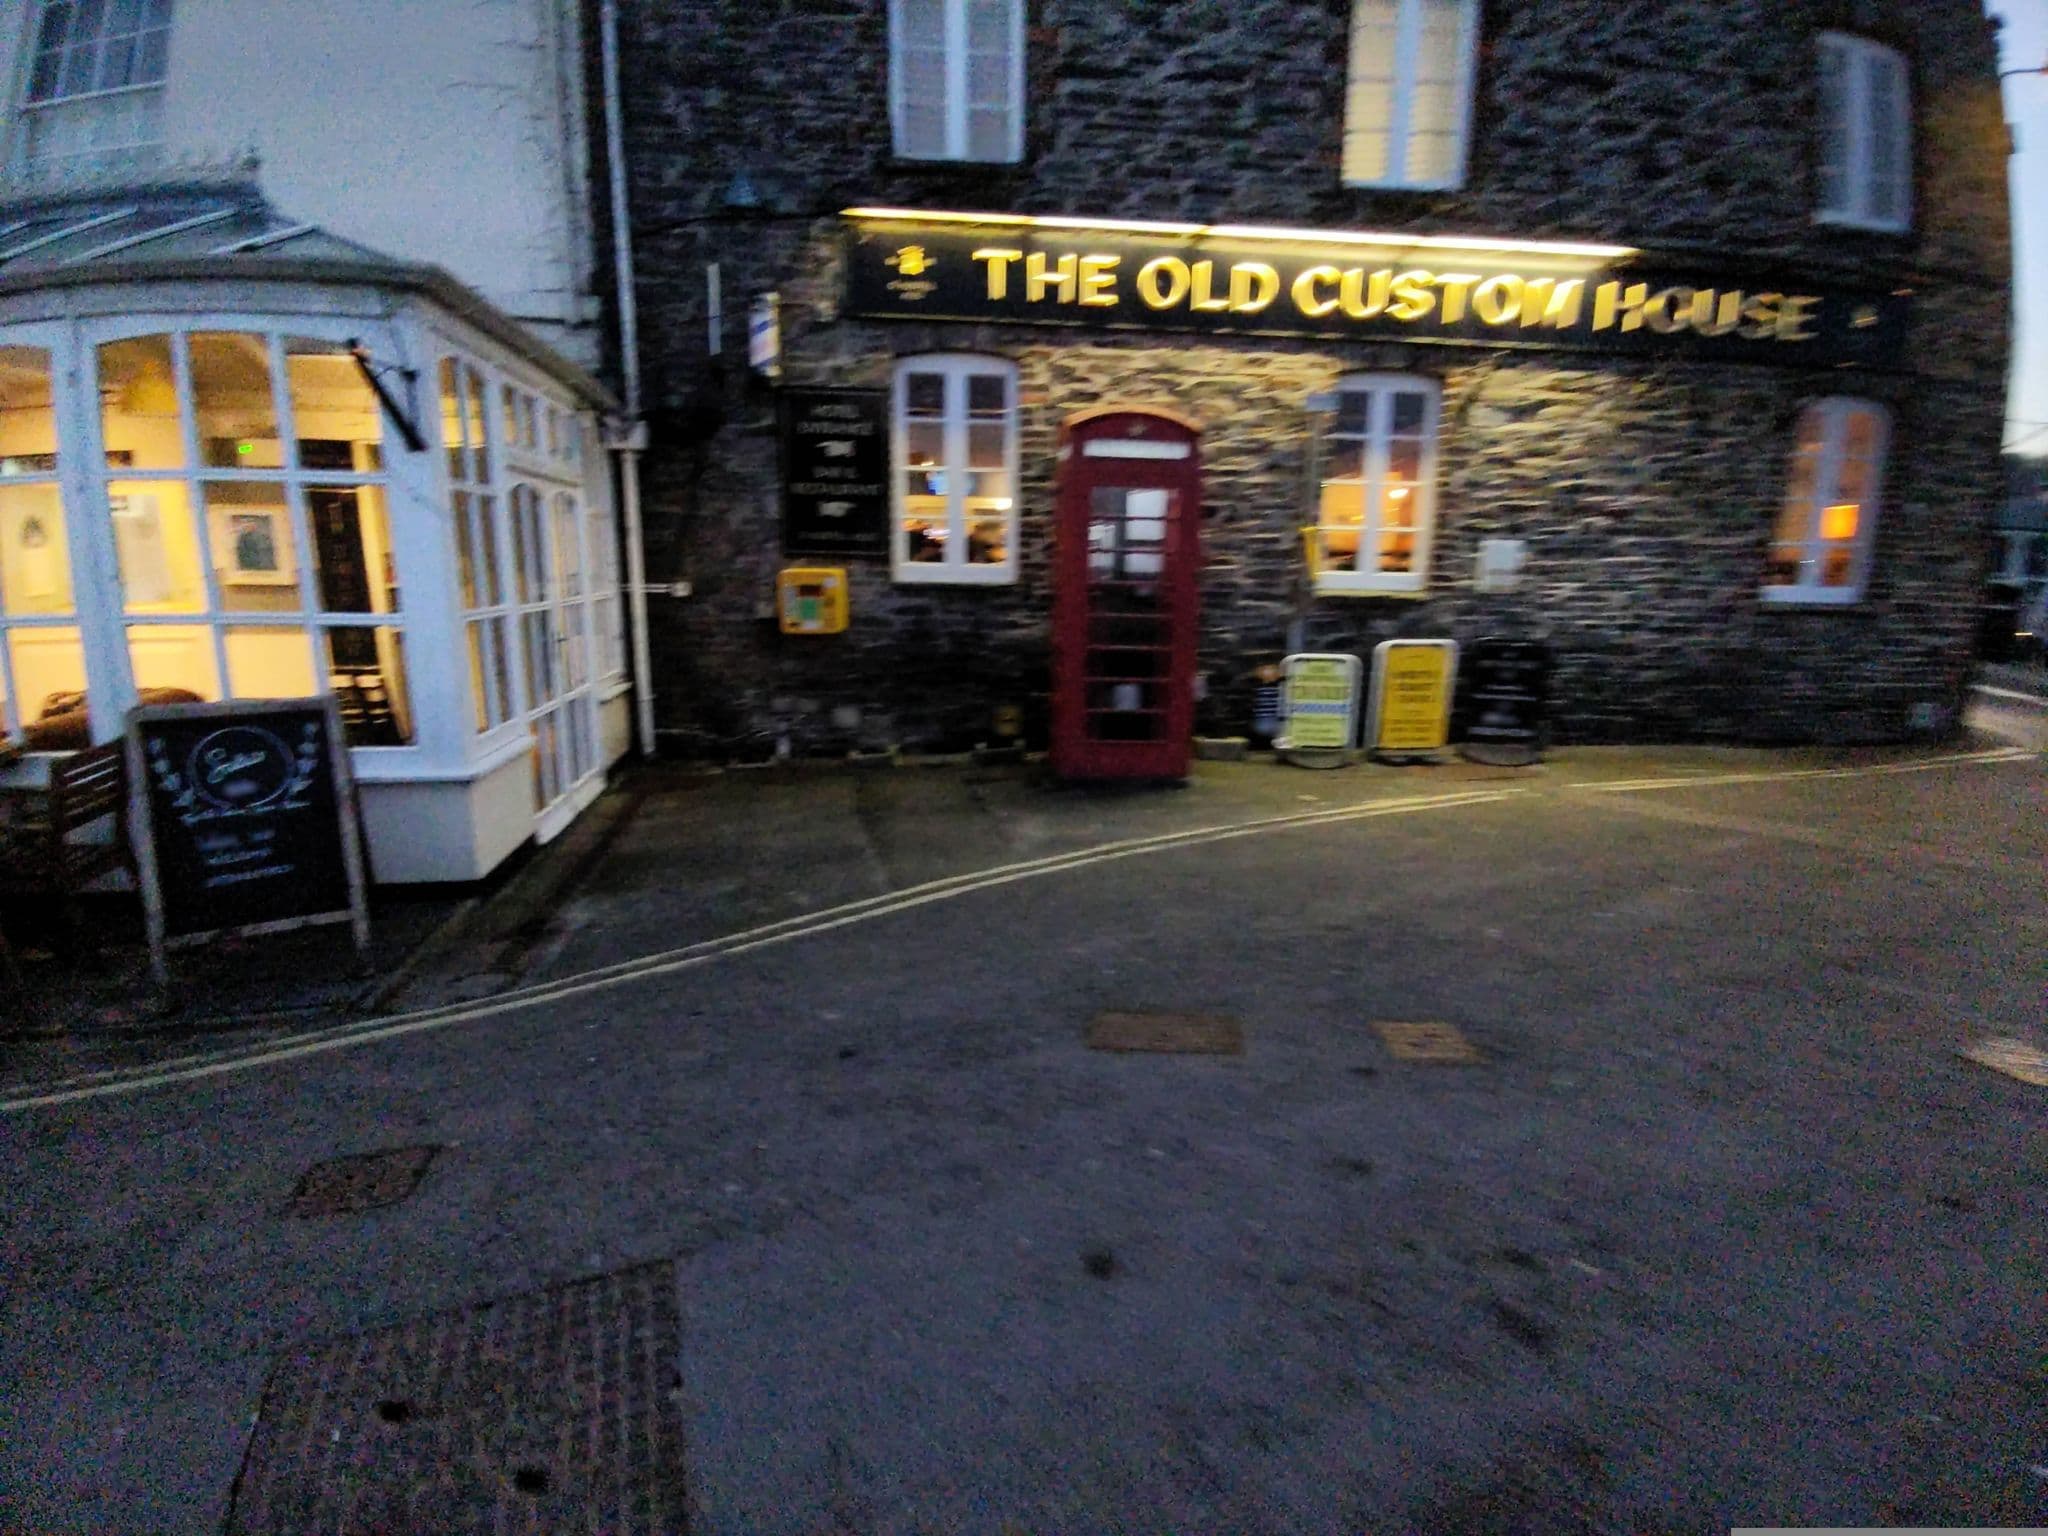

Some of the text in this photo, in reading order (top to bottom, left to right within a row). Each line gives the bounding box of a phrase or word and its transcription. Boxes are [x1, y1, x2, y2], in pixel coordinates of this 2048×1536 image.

[972, 248, 1824, 340] THE OLD CUSTOM HOUSE
